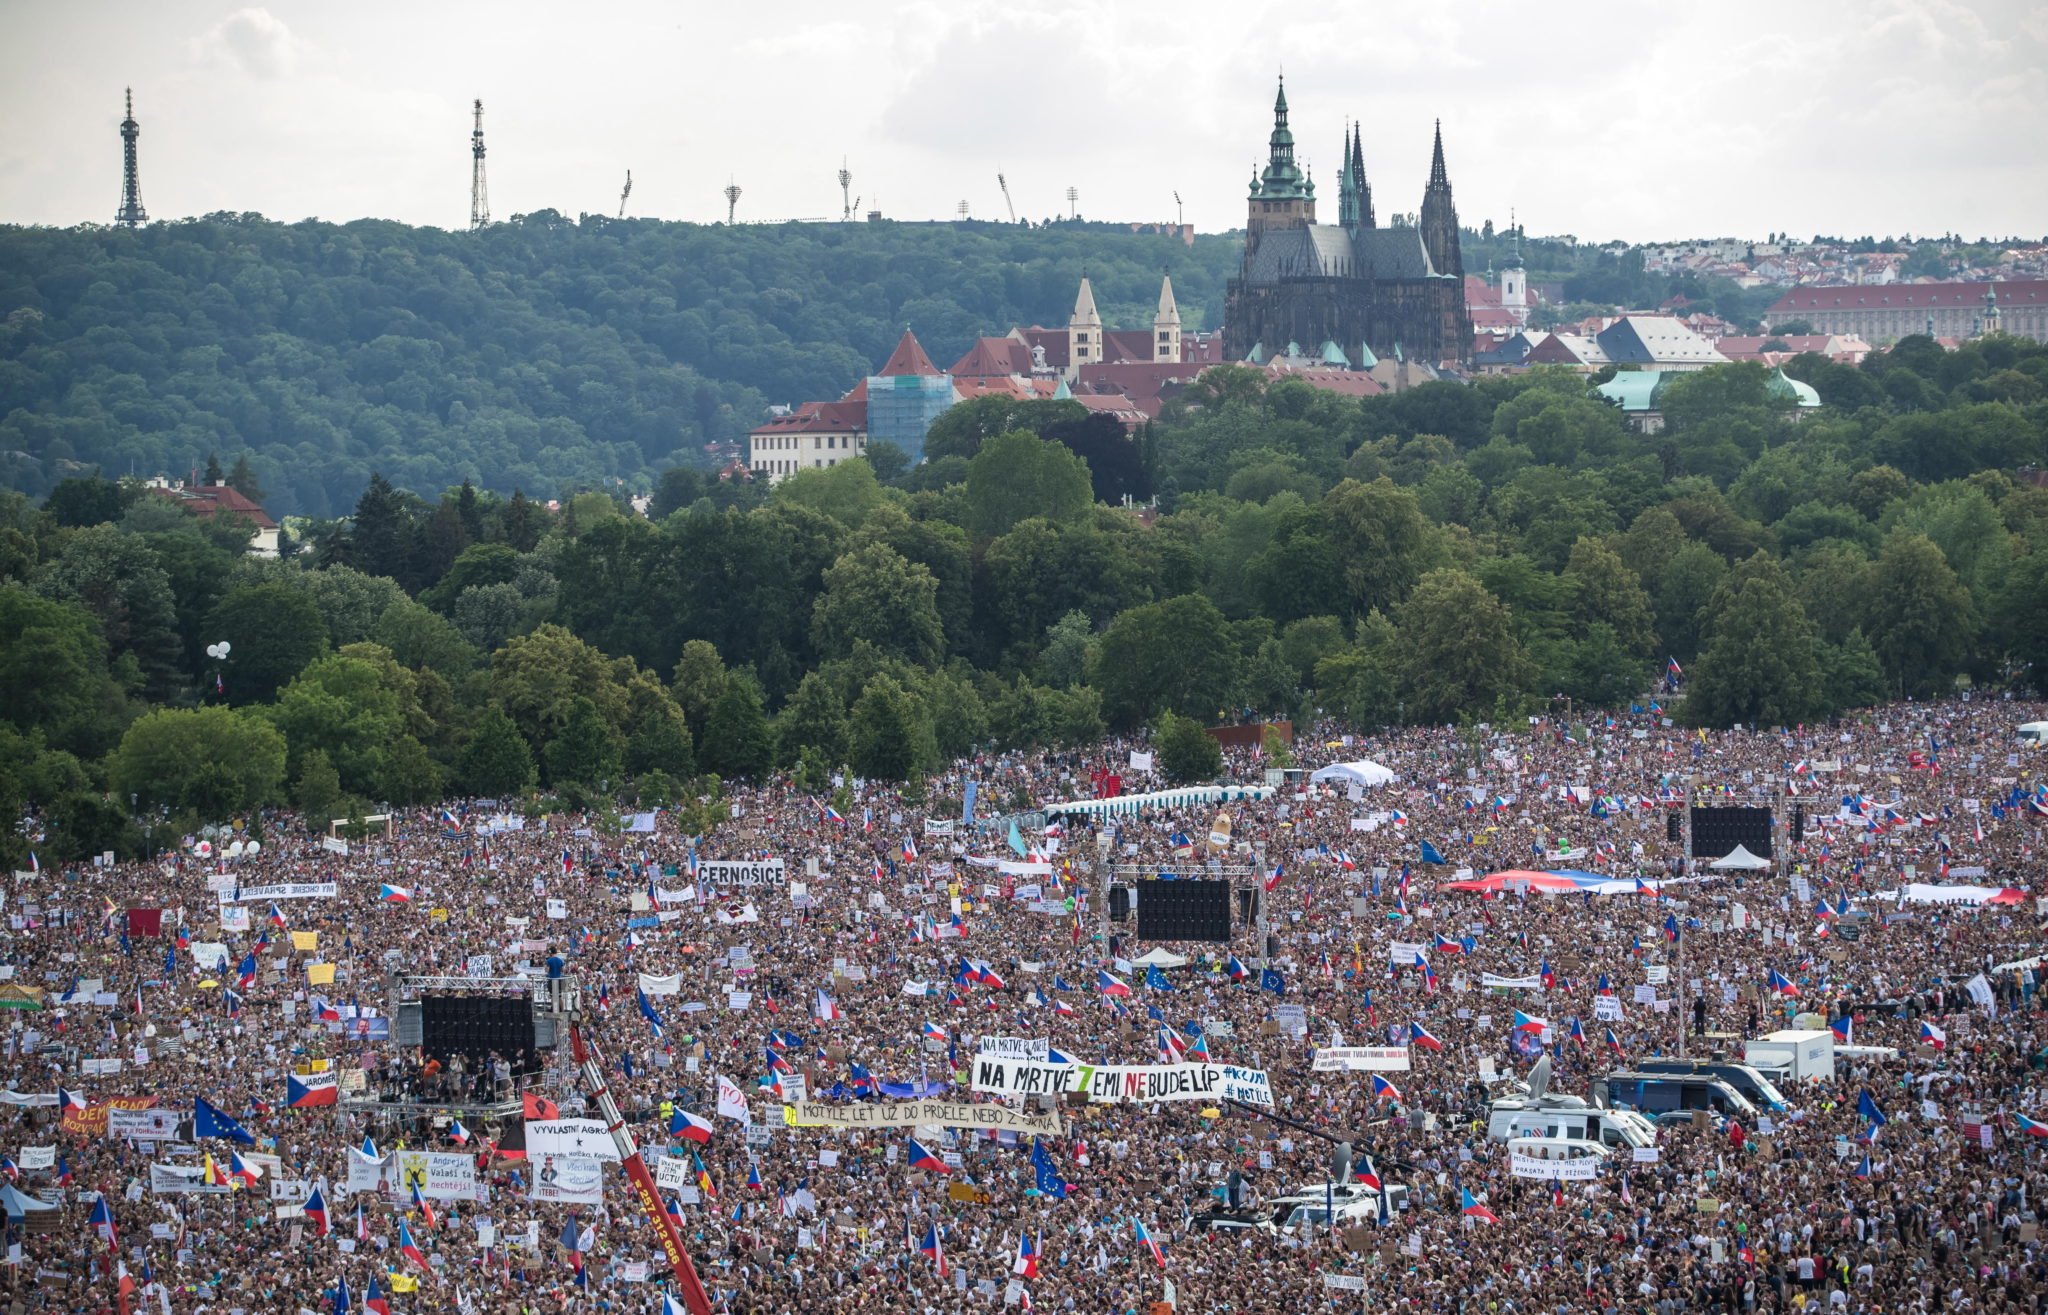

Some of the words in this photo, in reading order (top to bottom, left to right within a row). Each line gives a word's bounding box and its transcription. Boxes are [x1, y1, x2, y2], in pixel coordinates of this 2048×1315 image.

[698, 863, 784, 884] ČERNOŠICE
[983, 1038, 996, 1052] NA
[979, 1061, 1004, 1088] NA
[1013, 1063, 1074, 1094] MRTVÉ
[882, 1104, 898, 1121] UŽ
[904, 1105, 919, 1119] DO
[923, 1104, 969, 1123] PRDELE,
[973, 1108, 1003, 1124] NEBO
[1007, 1111, 1017, 1125] Z
[1515, 1166, 1545, 1175] PRASATA
[640, 1189, 656, 1212] 257
[652, 1215, 668, 1240] 312
[664, 1240, 680, 1265] 666
